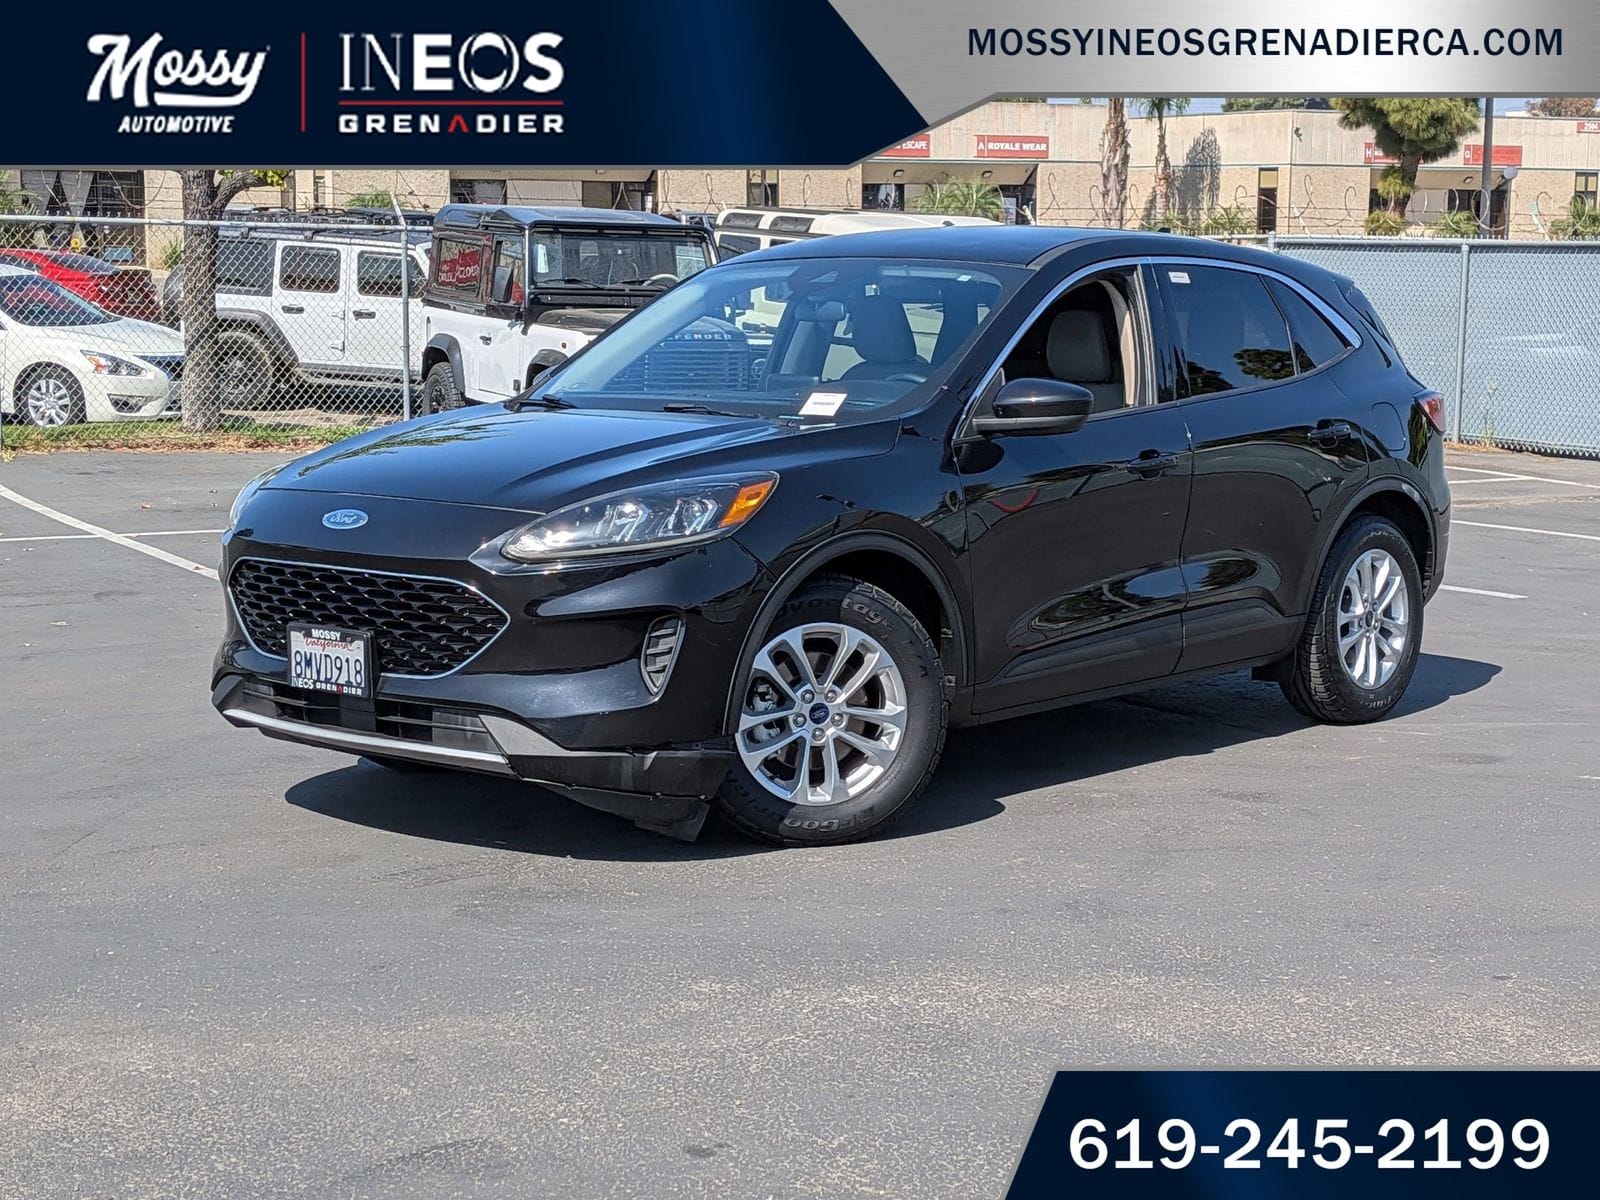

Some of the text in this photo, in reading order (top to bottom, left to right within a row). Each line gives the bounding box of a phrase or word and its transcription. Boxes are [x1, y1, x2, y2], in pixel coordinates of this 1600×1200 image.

[978, 142, 984, 150] A
[988, 142, 1048, 151] ROYALE WEAR
[312, 629, 341, 641] MOSSY
[294, 649, 363, 687] 8MVD918
